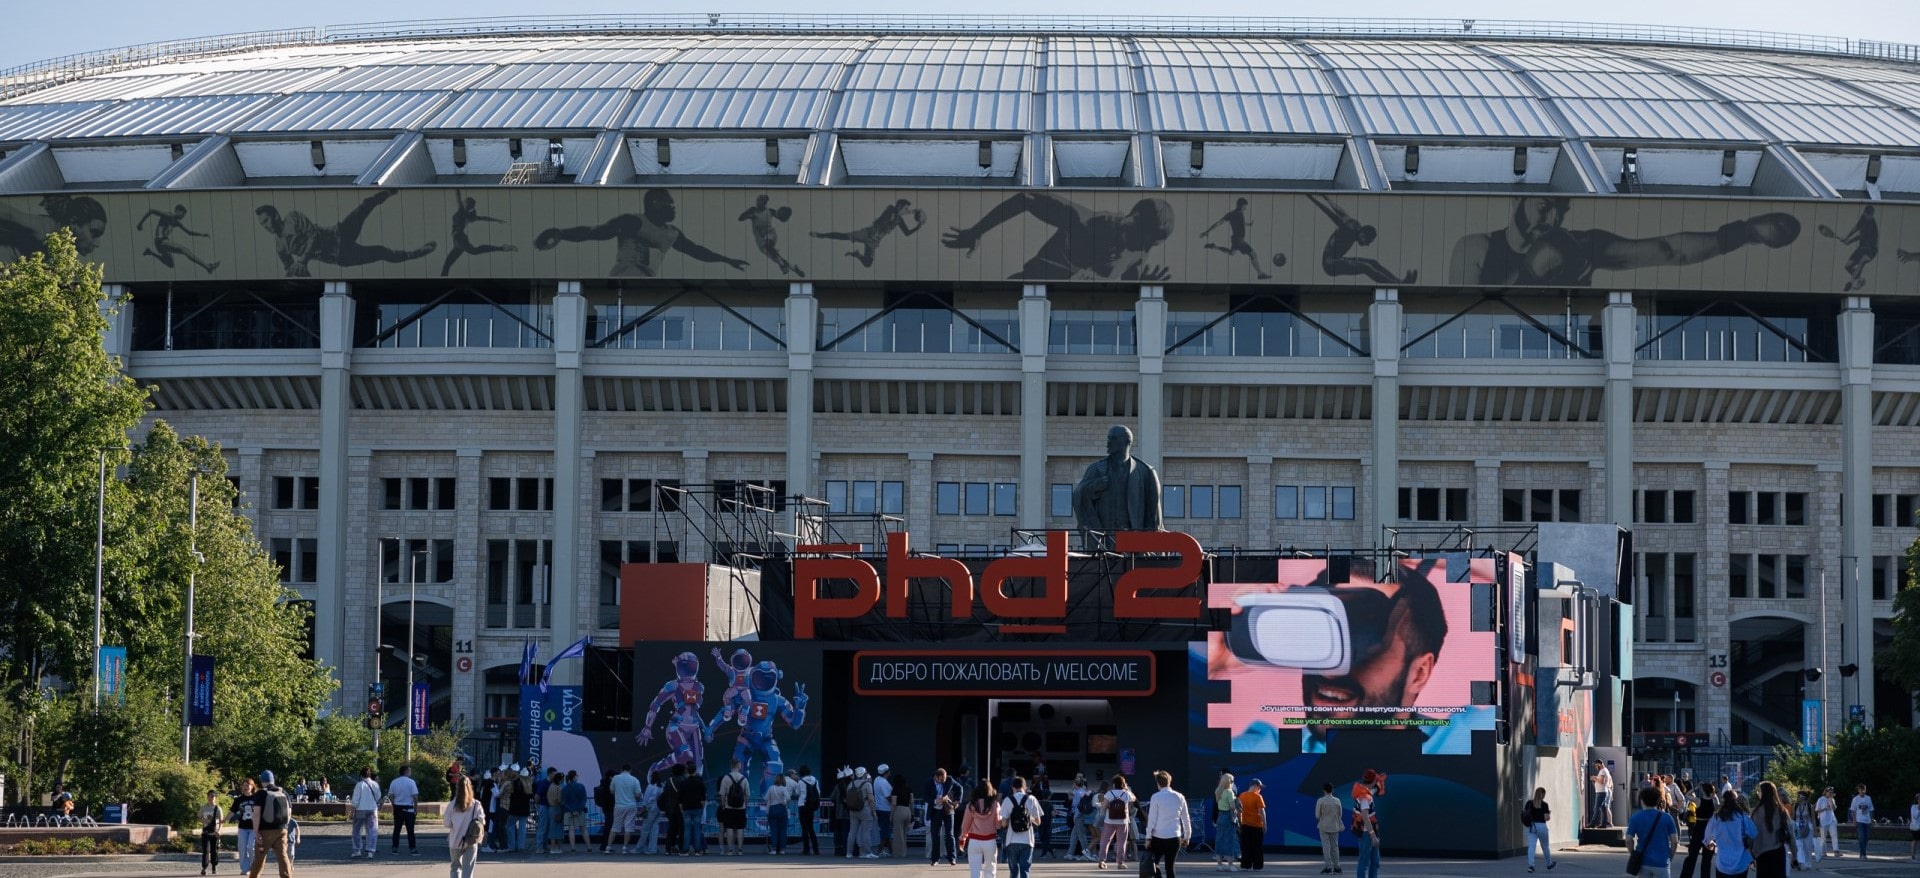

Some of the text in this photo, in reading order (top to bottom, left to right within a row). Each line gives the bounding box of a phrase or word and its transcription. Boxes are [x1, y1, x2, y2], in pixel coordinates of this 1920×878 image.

[1114, 531, 1204, 618] 2
[455, 639, 473, 653] 11
[1709, 654, 1728, 668] 13
[870, 662, 928, 683] ДОБРО
[931, 662, 1041, 682] ПОЖАЛОВАТЬ
[1053, 662, 1138, 682] WELCOME
[1260, 705, 1312, 713] Осуществите
[529, 700, 541, 766] еленная
